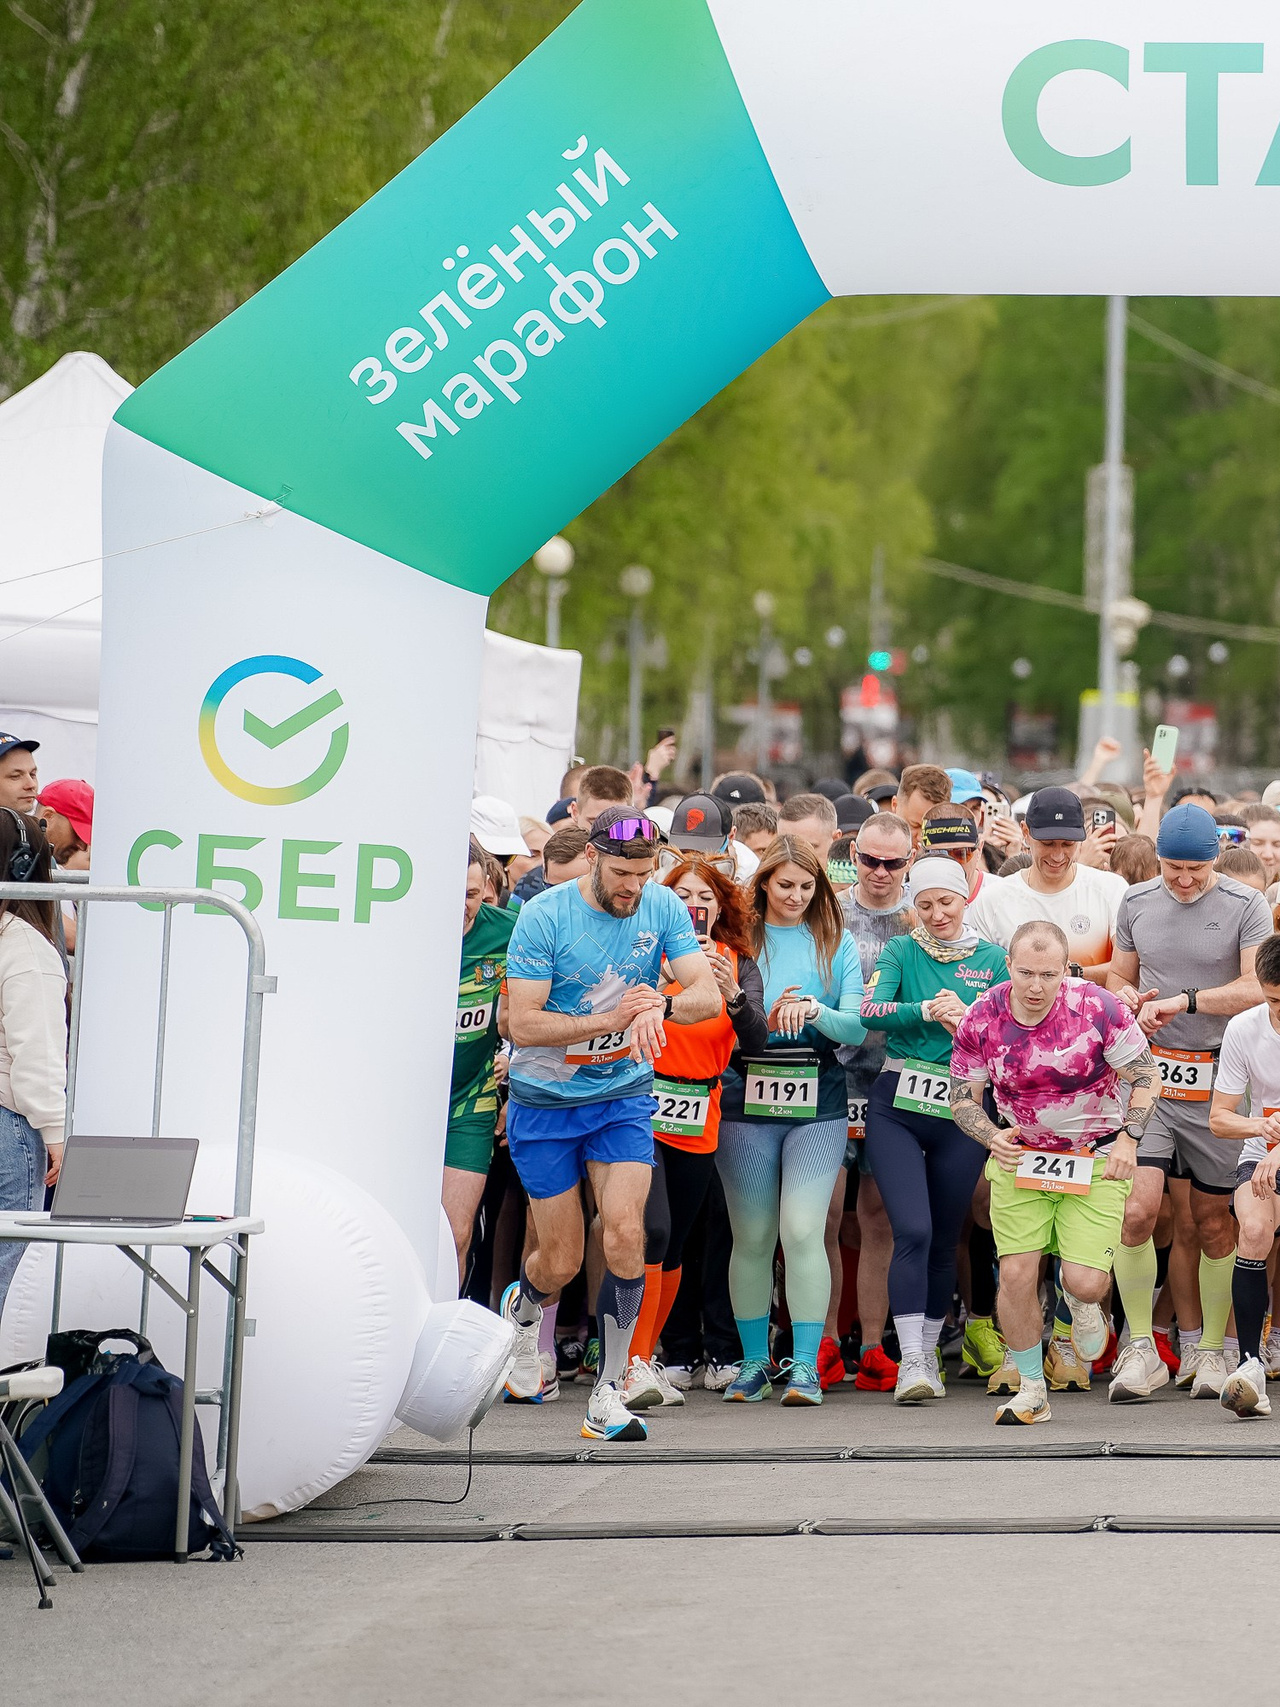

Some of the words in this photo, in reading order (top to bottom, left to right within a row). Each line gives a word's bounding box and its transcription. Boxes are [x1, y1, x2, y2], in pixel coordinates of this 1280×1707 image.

[349, 134, 631, 405] зелёный
[395, 201, 679, 460] марафон
[127, 829, 414, 924] СБЕР
[456, 1008, 486, 1029] 00
[588, 1031, 625, 1052] 123
[1158, 1062, 1198, 1085] 363
[754, 1080, 809, 1102] 1191
[907, 1075, 951, 1101] 112
[1032, 1155, 1075, 1179] 241
